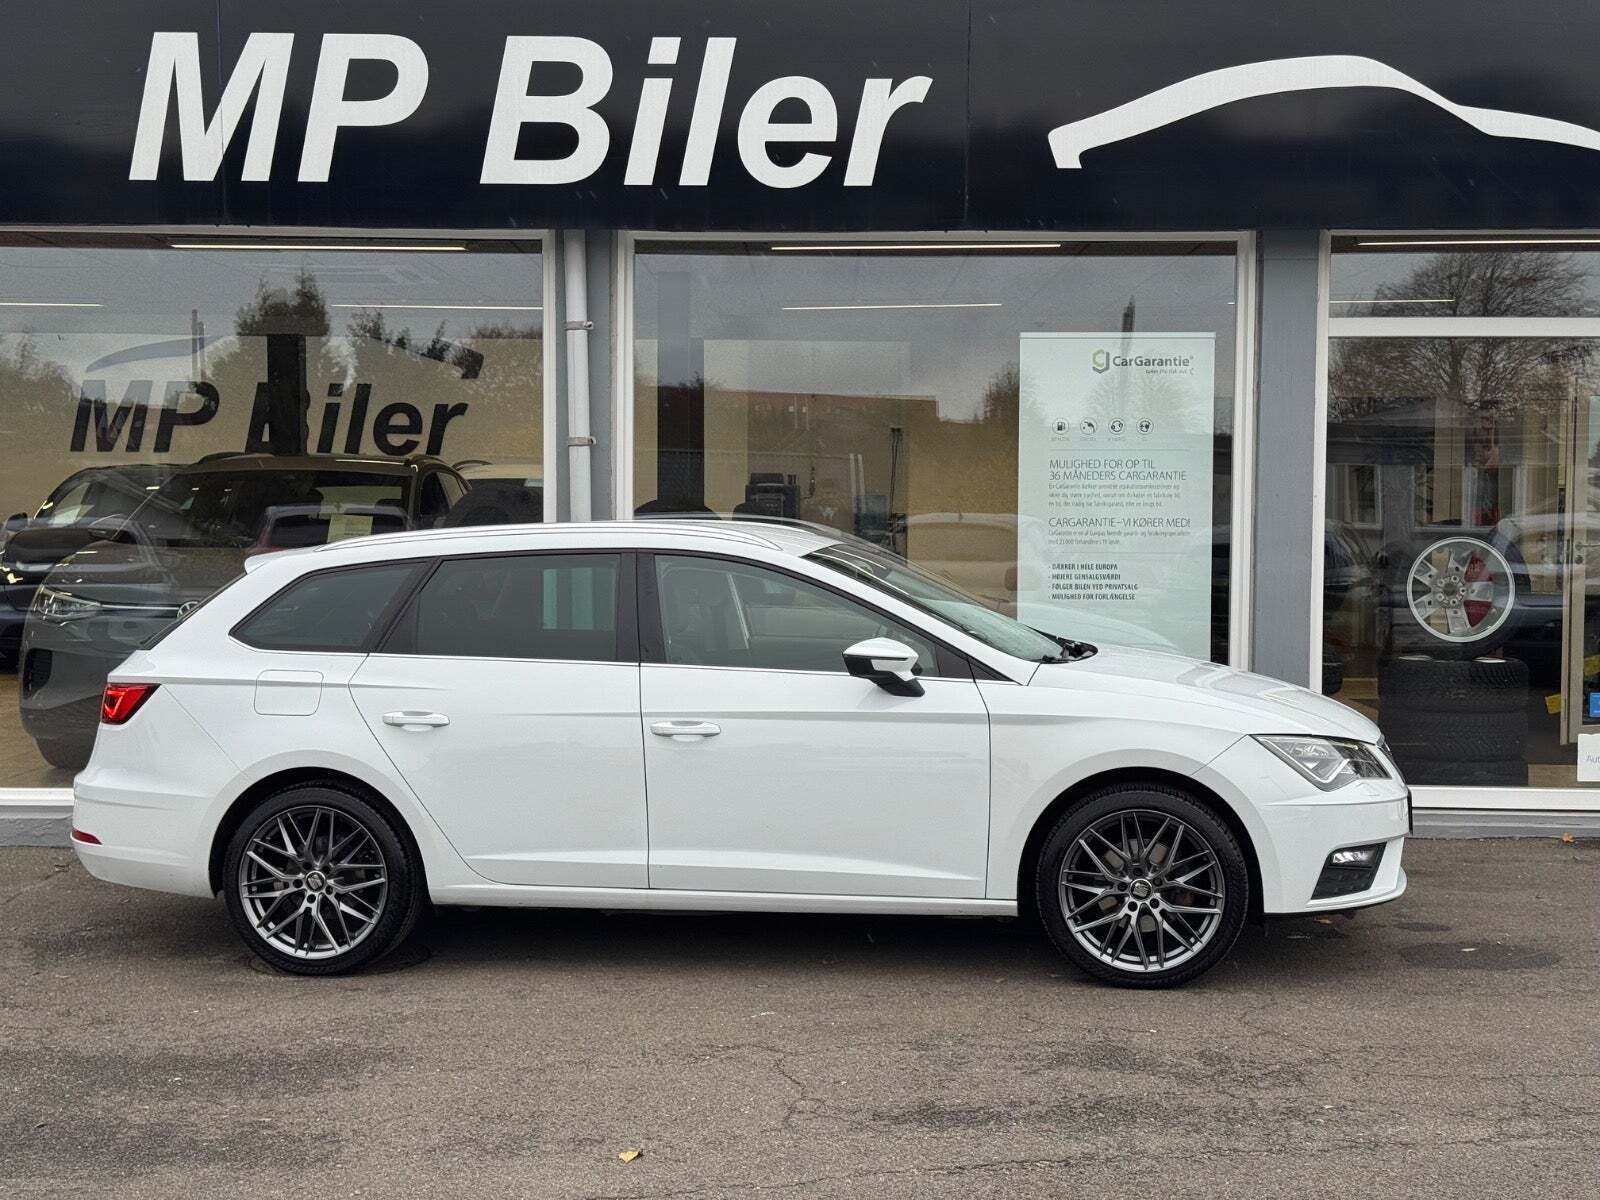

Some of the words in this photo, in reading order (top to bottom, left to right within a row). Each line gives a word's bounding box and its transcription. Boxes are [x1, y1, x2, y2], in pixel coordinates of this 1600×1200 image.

[128, 31, 429, 183] MP
[480, 35, 933, 189] Biler
[70, 379, 220, 453] MP
[1049, 459, 1101, 470] MULIGHED
[1103, 459, 1123, 470] FOR
[1125, 459, 1140, 470] OP
[1142, 459, 1156, 469] TIL
[1049, 471, 1061, 481] 36
[1063, 470, 1116, 481] MÅNEDERS
[1118, 471, 1187, 481] CARGARANTIE
[1133, 517, 1164, 528] KØRER
[1095, 563, 1119, 571] EUROPA
